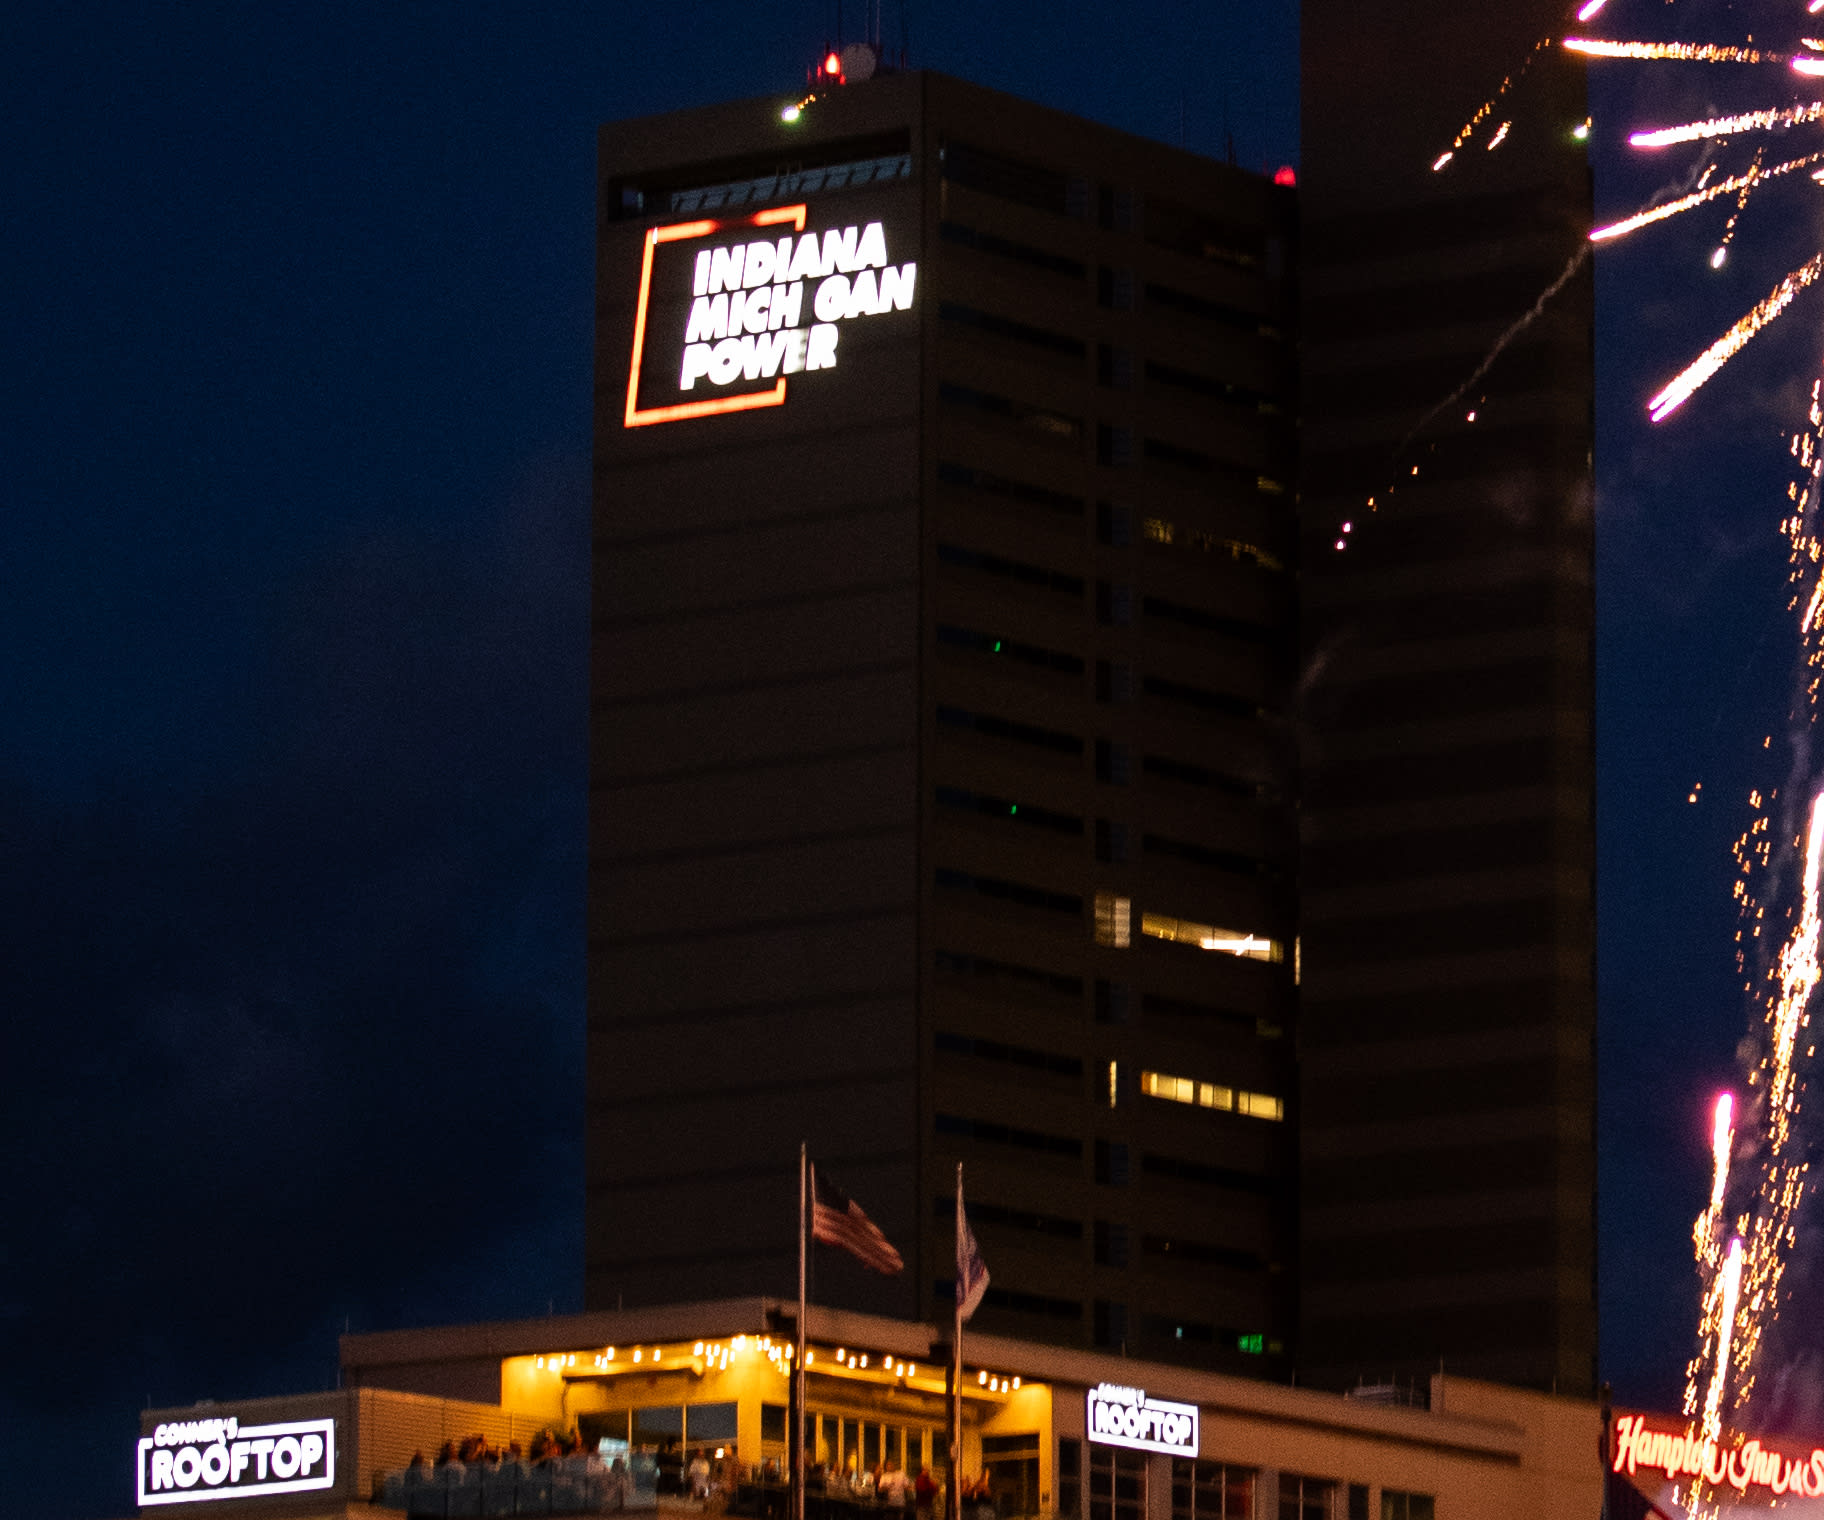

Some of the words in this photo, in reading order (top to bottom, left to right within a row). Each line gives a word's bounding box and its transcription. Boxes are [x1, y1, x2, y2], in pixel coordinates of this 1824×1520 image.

[692, 222, 887, 296] INDIANA
[684, 263, 917, 343] MICHGAN
[679, 323, 839, 391] POWER
[152, 1434, 323, 1490] ROOFTOP
[1728, 1440, 1790, 1494] Inn
